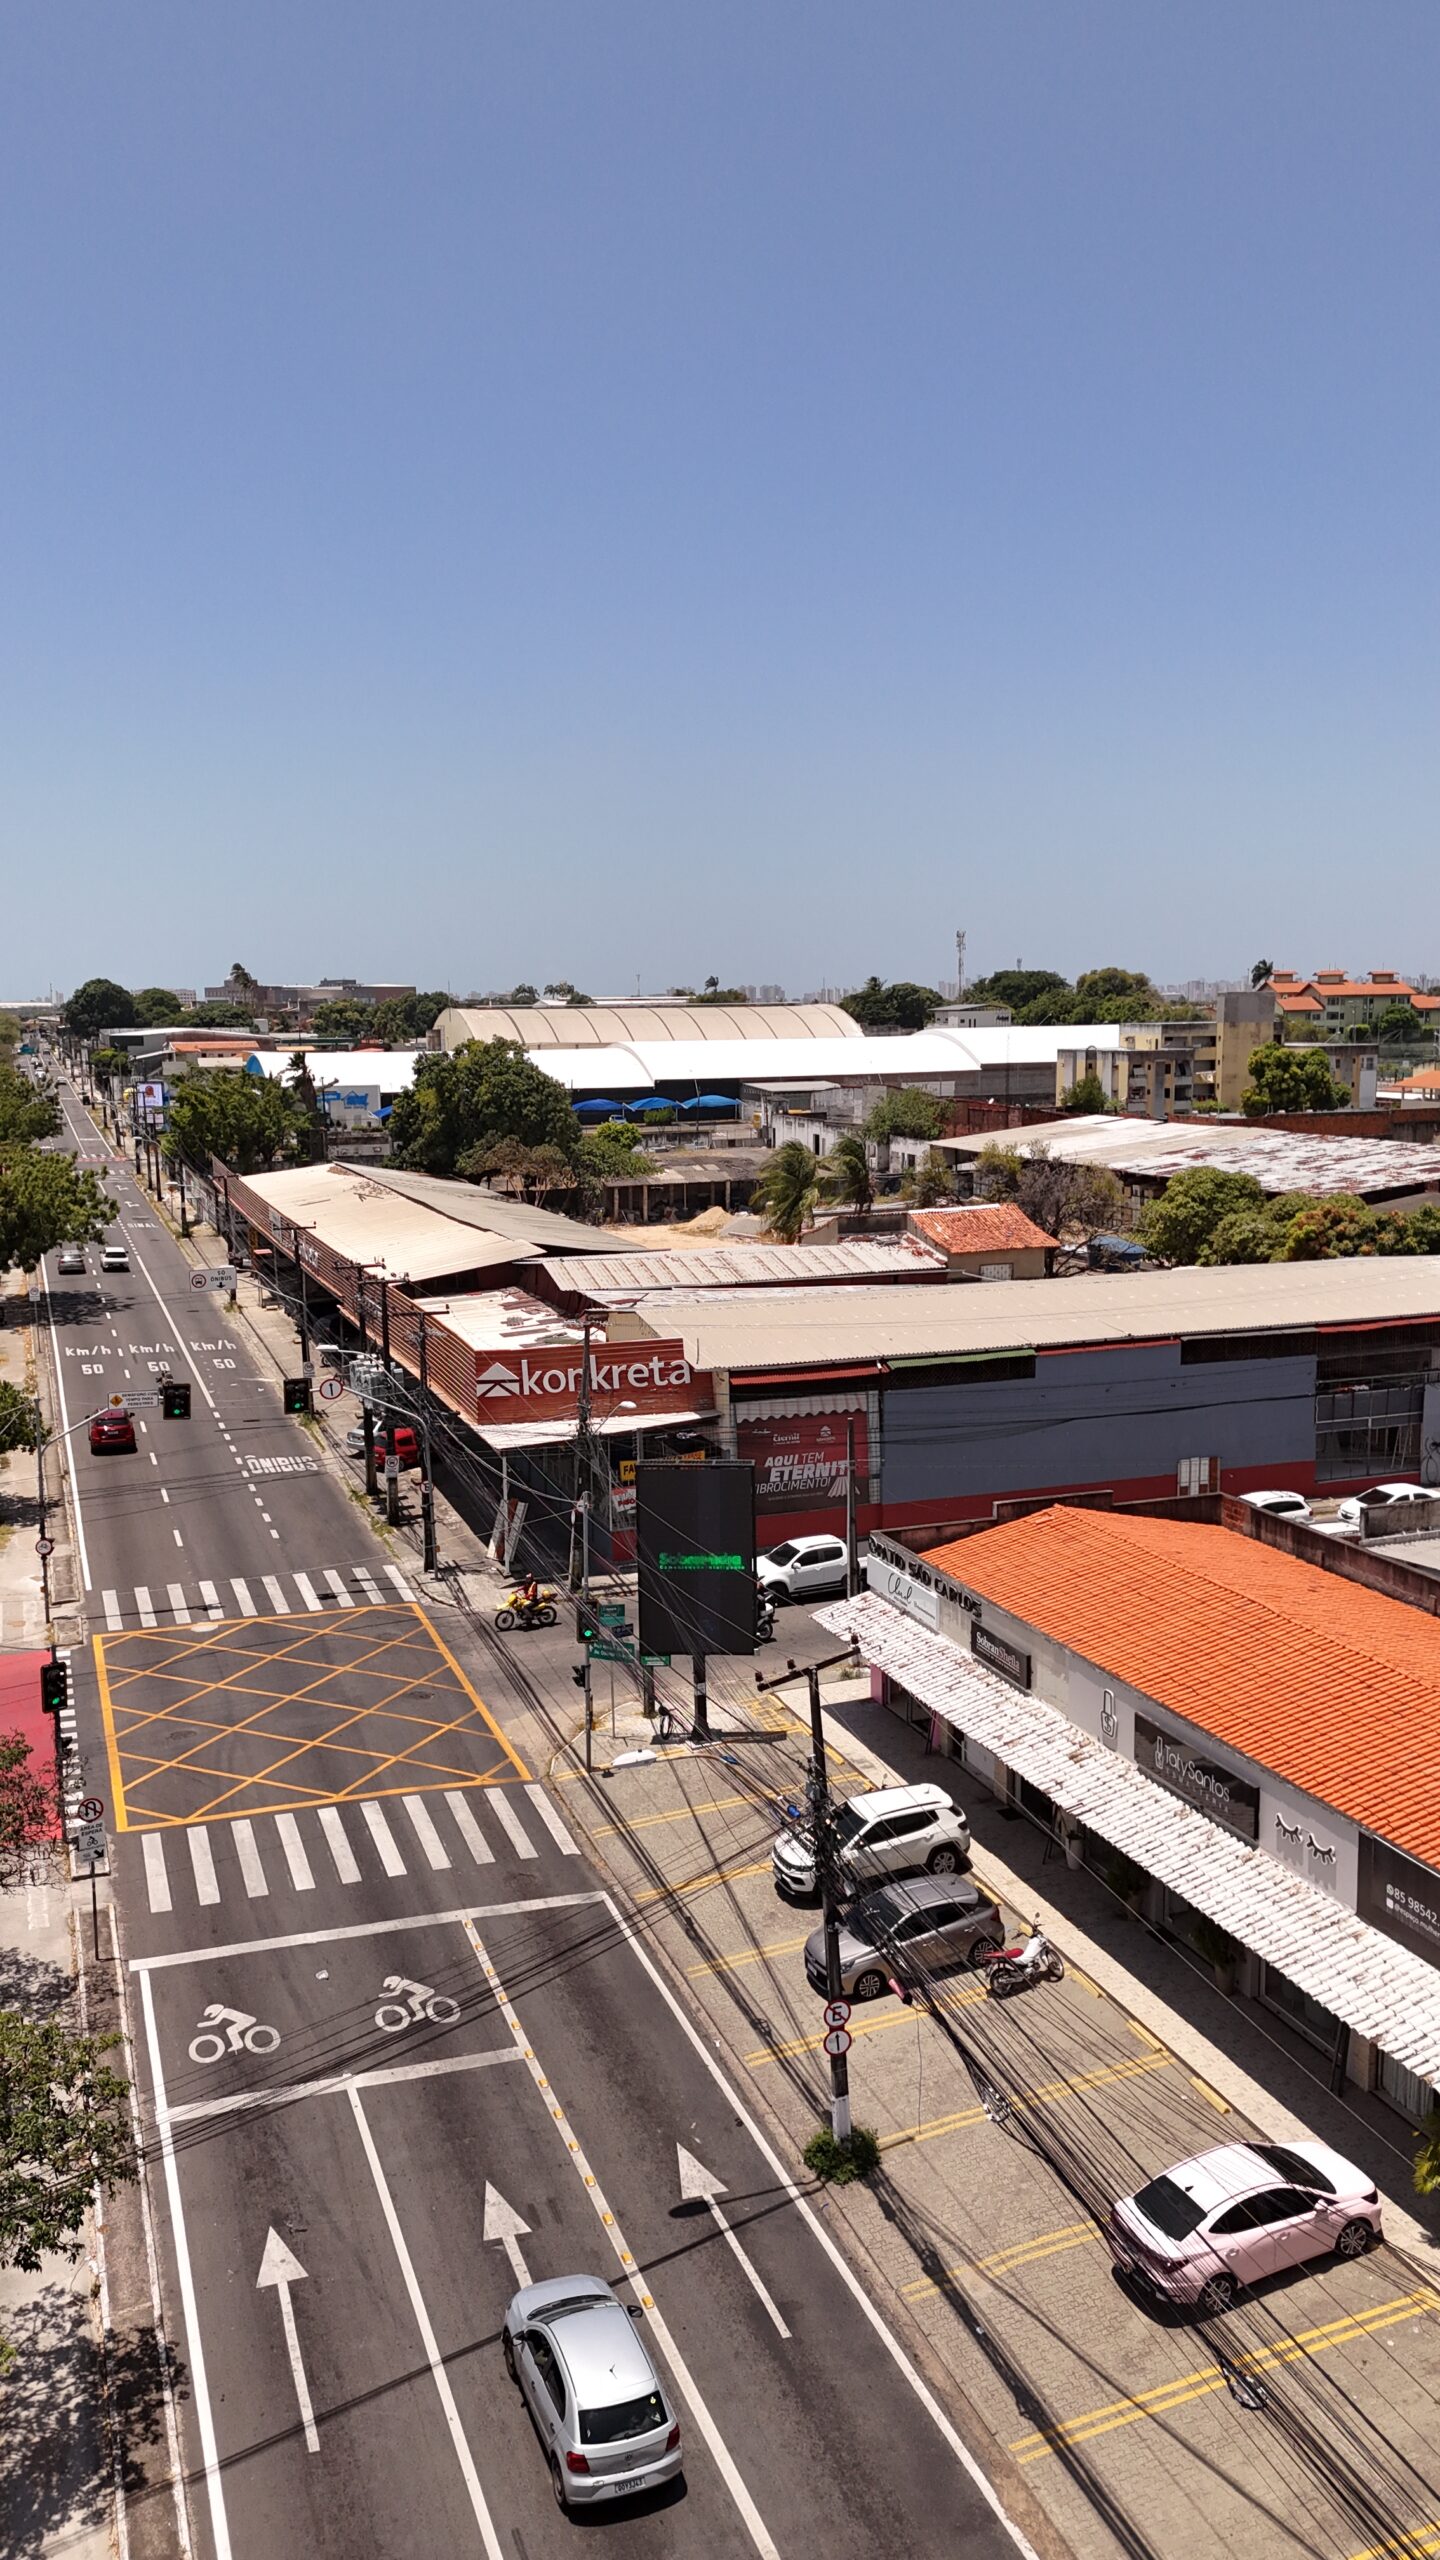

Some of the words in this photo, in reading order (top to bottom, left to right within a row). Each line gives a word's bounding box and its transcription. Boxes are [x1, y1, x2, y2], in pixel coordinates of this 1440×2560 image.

[81, 1364, 104, 1375] 50
[147, 1361, 171, 1372] 50
[213, 1358, 236, 1369] 50
[521, 1354, 692, 1396] konkreta
[244, 1454, 319, 1475] ÔNIBUS
[764, 1453, 799, 1468] AQUI
[801, 1451, 825, 1464] TEM
[769, 1460, 848, 1483] ETERNIT
[935, 1578, 982, 1618] CARLOS
[1394, 1887, 1406, 1904] 85
[832, 2005, 843, 2022] E
